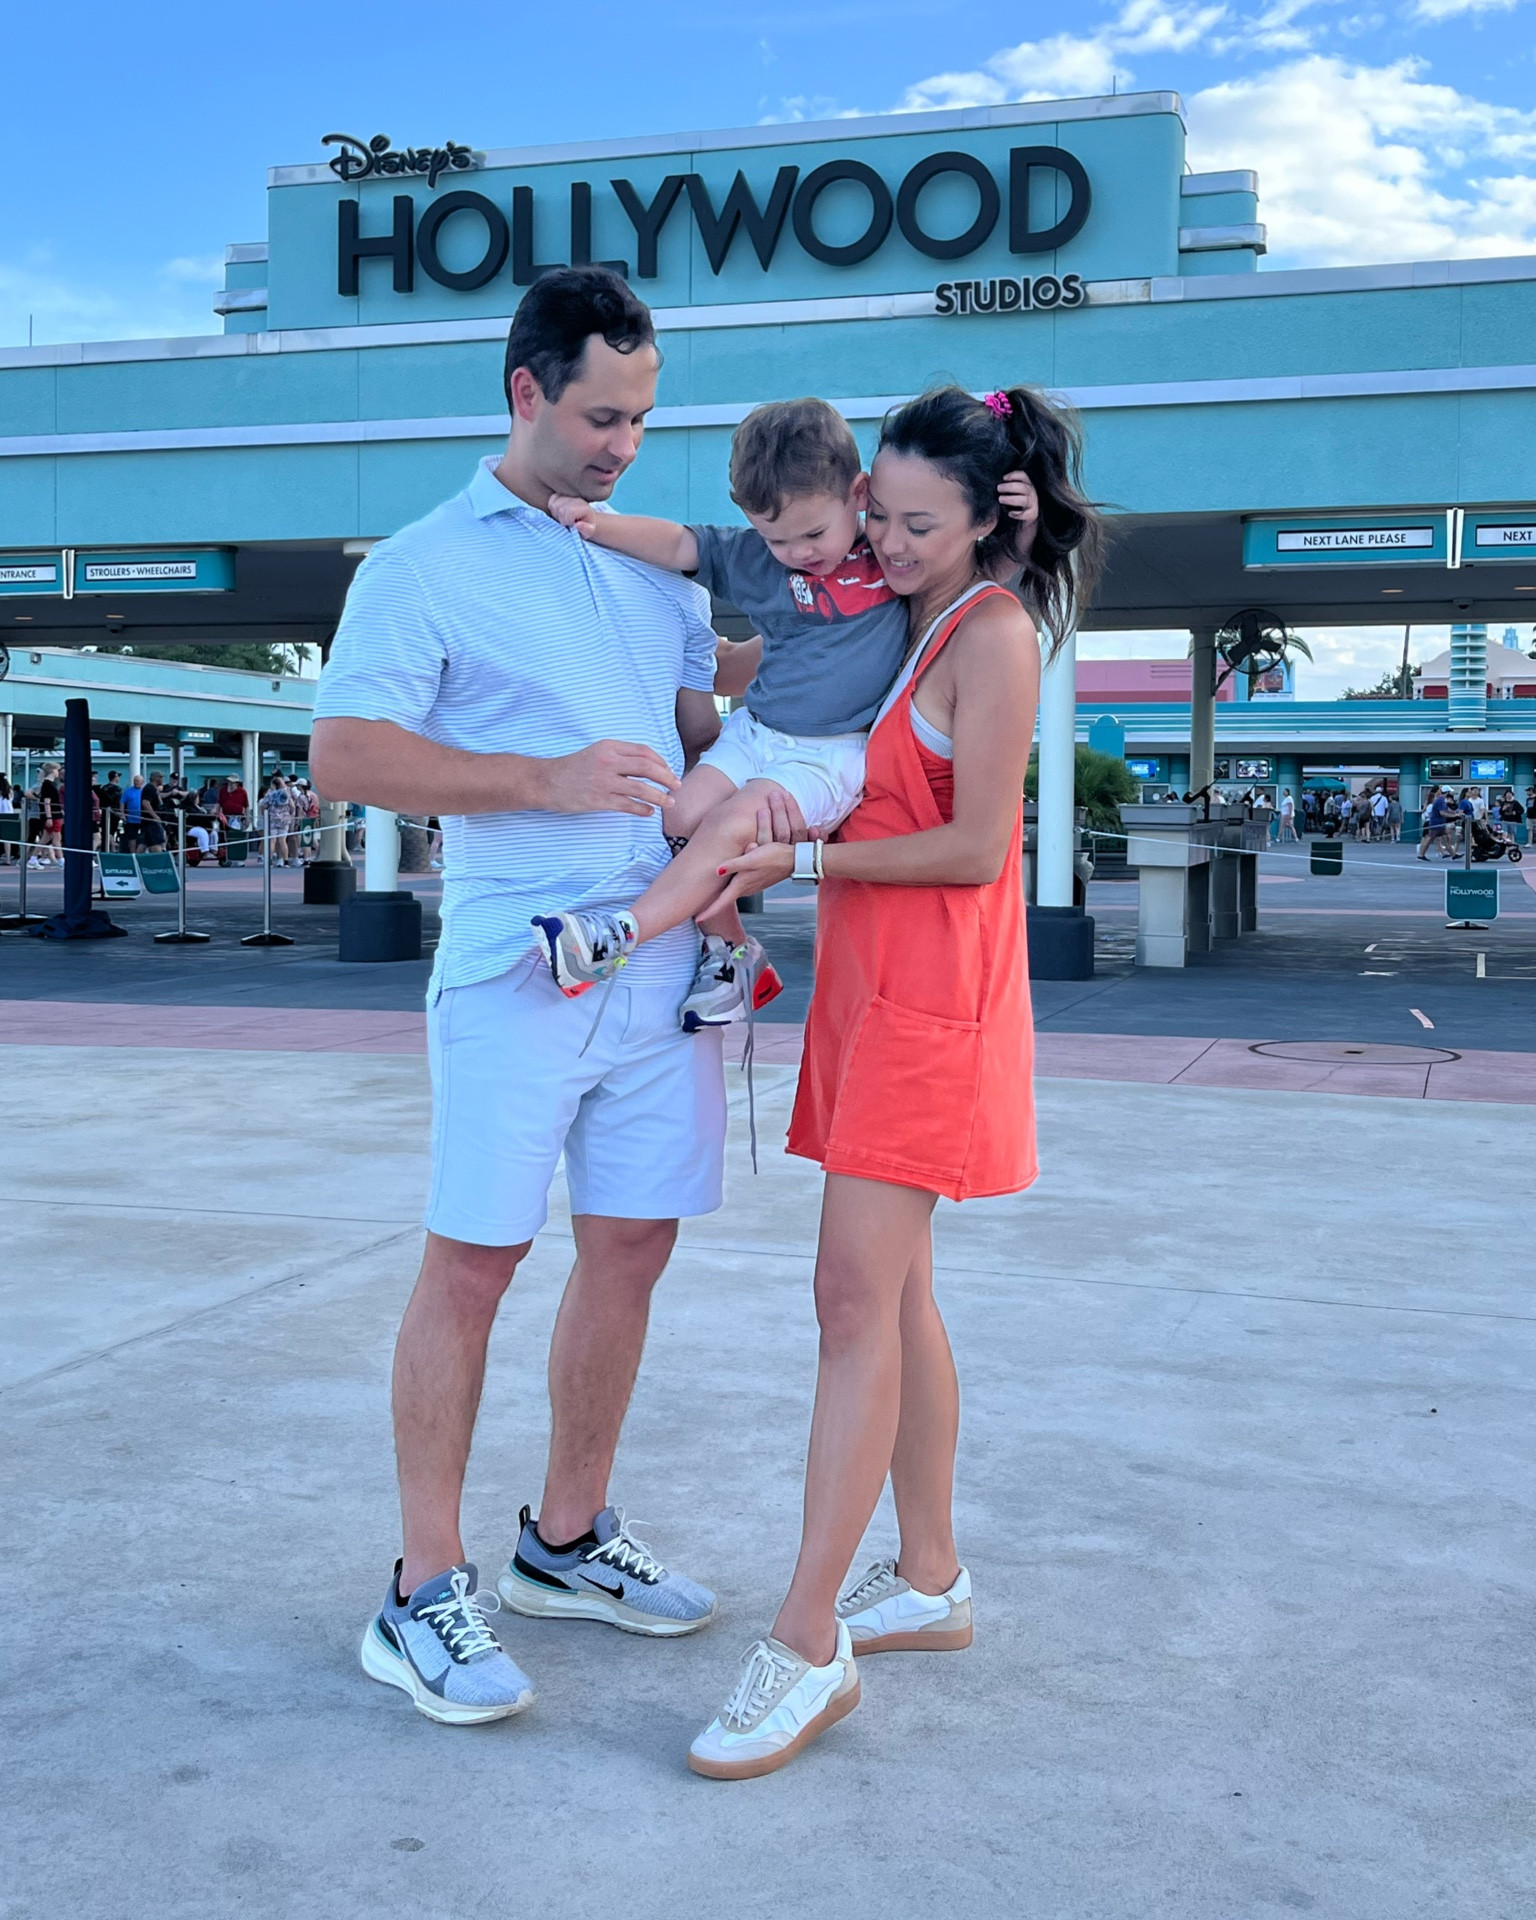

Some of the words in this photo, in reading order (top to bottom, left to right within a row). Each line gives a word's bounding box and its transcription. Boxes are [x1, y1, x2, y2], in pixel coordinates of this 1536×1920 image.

[338, 145, 1092, 297] HOLLYWOOD
[935, 273, 1085, 316] STUDIOS
[1303, 535, 1332, 546] NEXT
[1335, 534, 1364, 545] LANE
[1368, 533, 1406, 544] PLEASE
[1503, 530, 1533, 541] NEXT
[0, 570, 37, 579] NTRANCE
[90, 567, 131, 577] STROLLERS
[136, 565, 192, 575] WHEELCHAIRS
[1450, 888, 1494, 896] HOLLYWOOD
